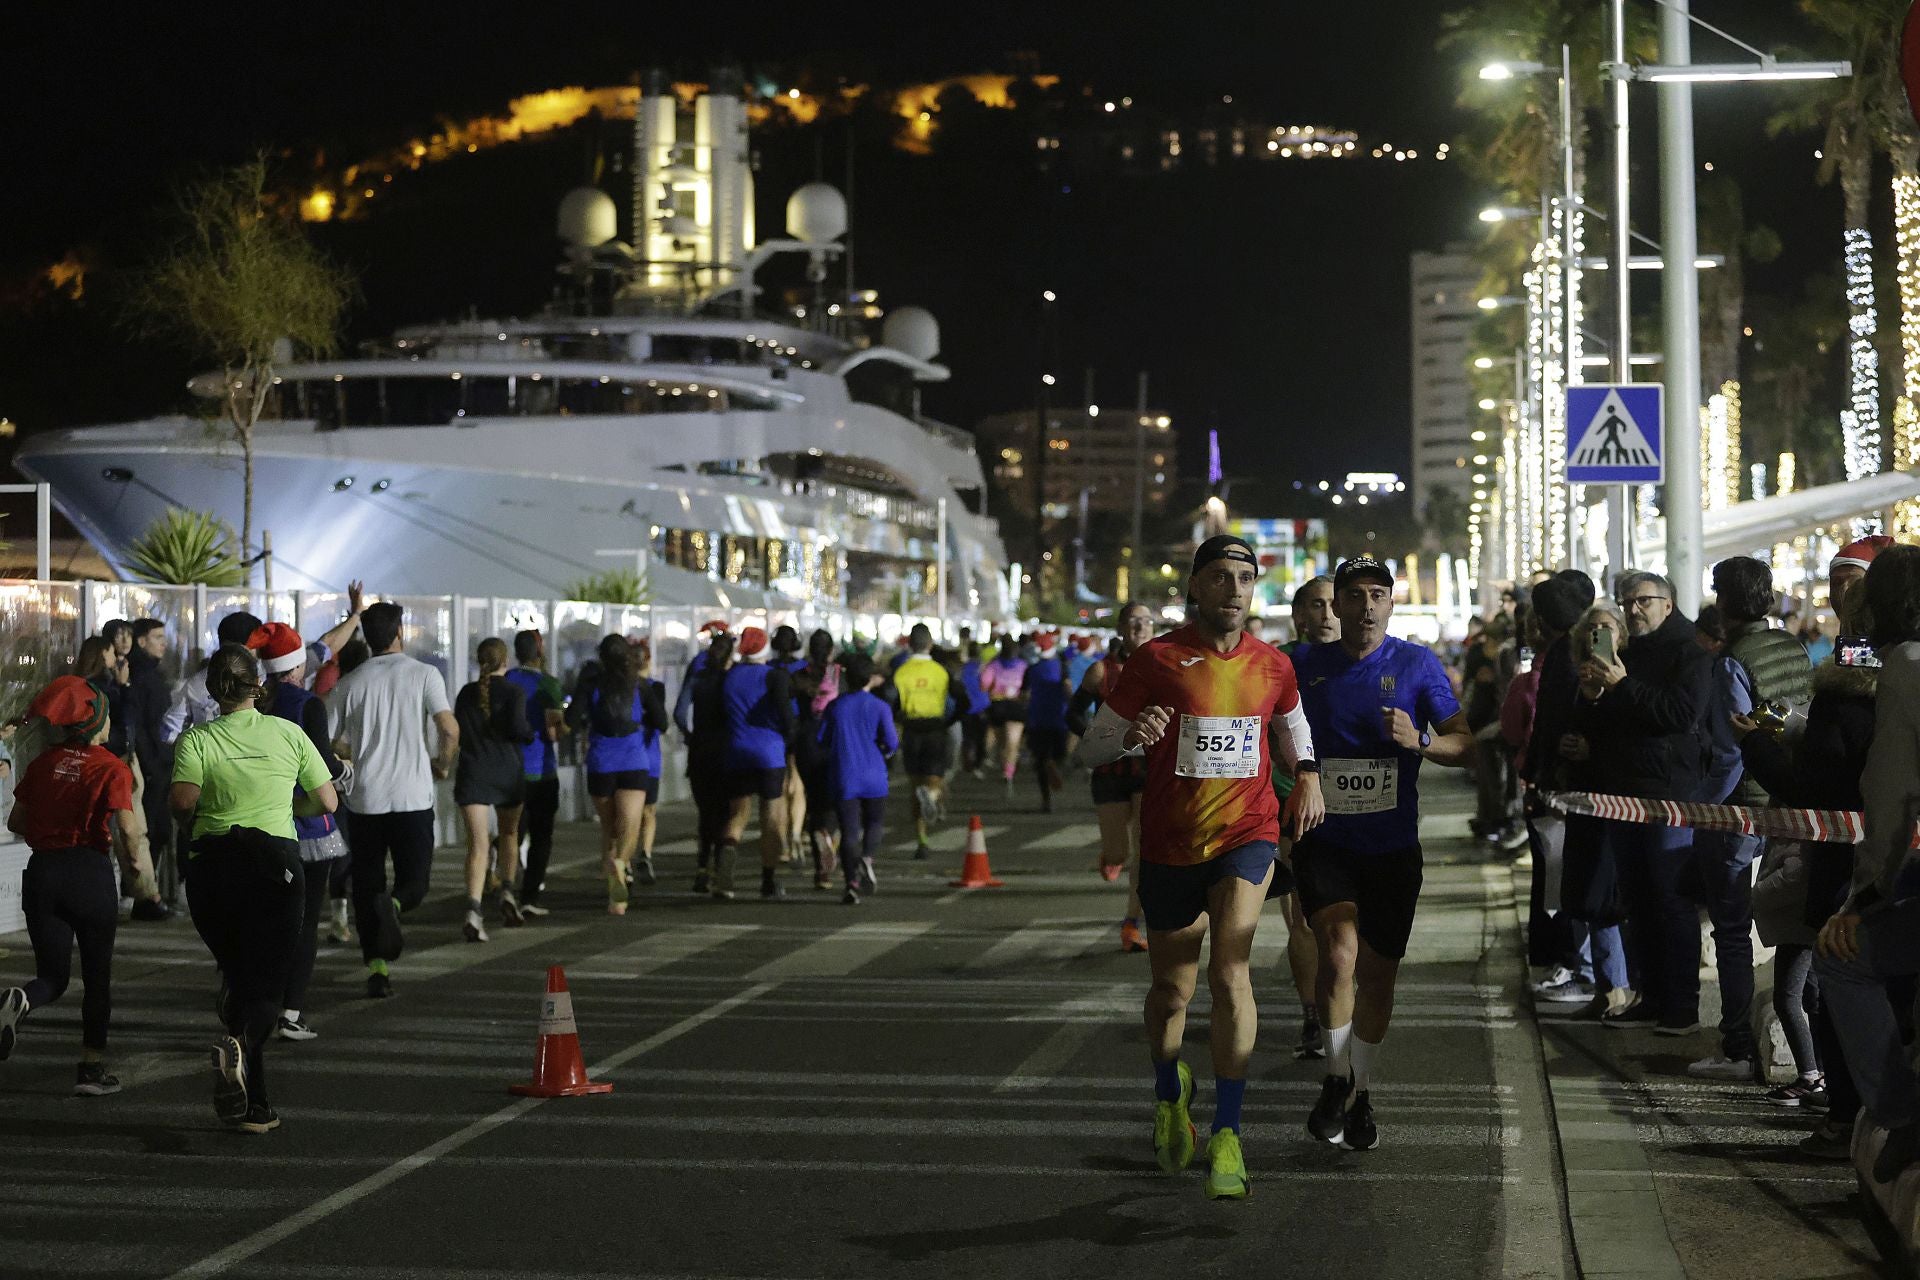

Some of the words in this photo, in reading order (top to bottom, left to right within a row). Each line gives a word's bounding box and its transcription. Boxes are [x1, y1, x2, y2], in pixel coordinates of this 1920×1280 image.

[1231, 719, 1242, 729] M
[1195, 735, 1236, 752] 552
[1210, 761, 1238, 769] mayoral
[1369, 761, 1380, 770] M
[1336, 775, 1376, 791] 900
[1351, 798, 1377, 806] mayoral
